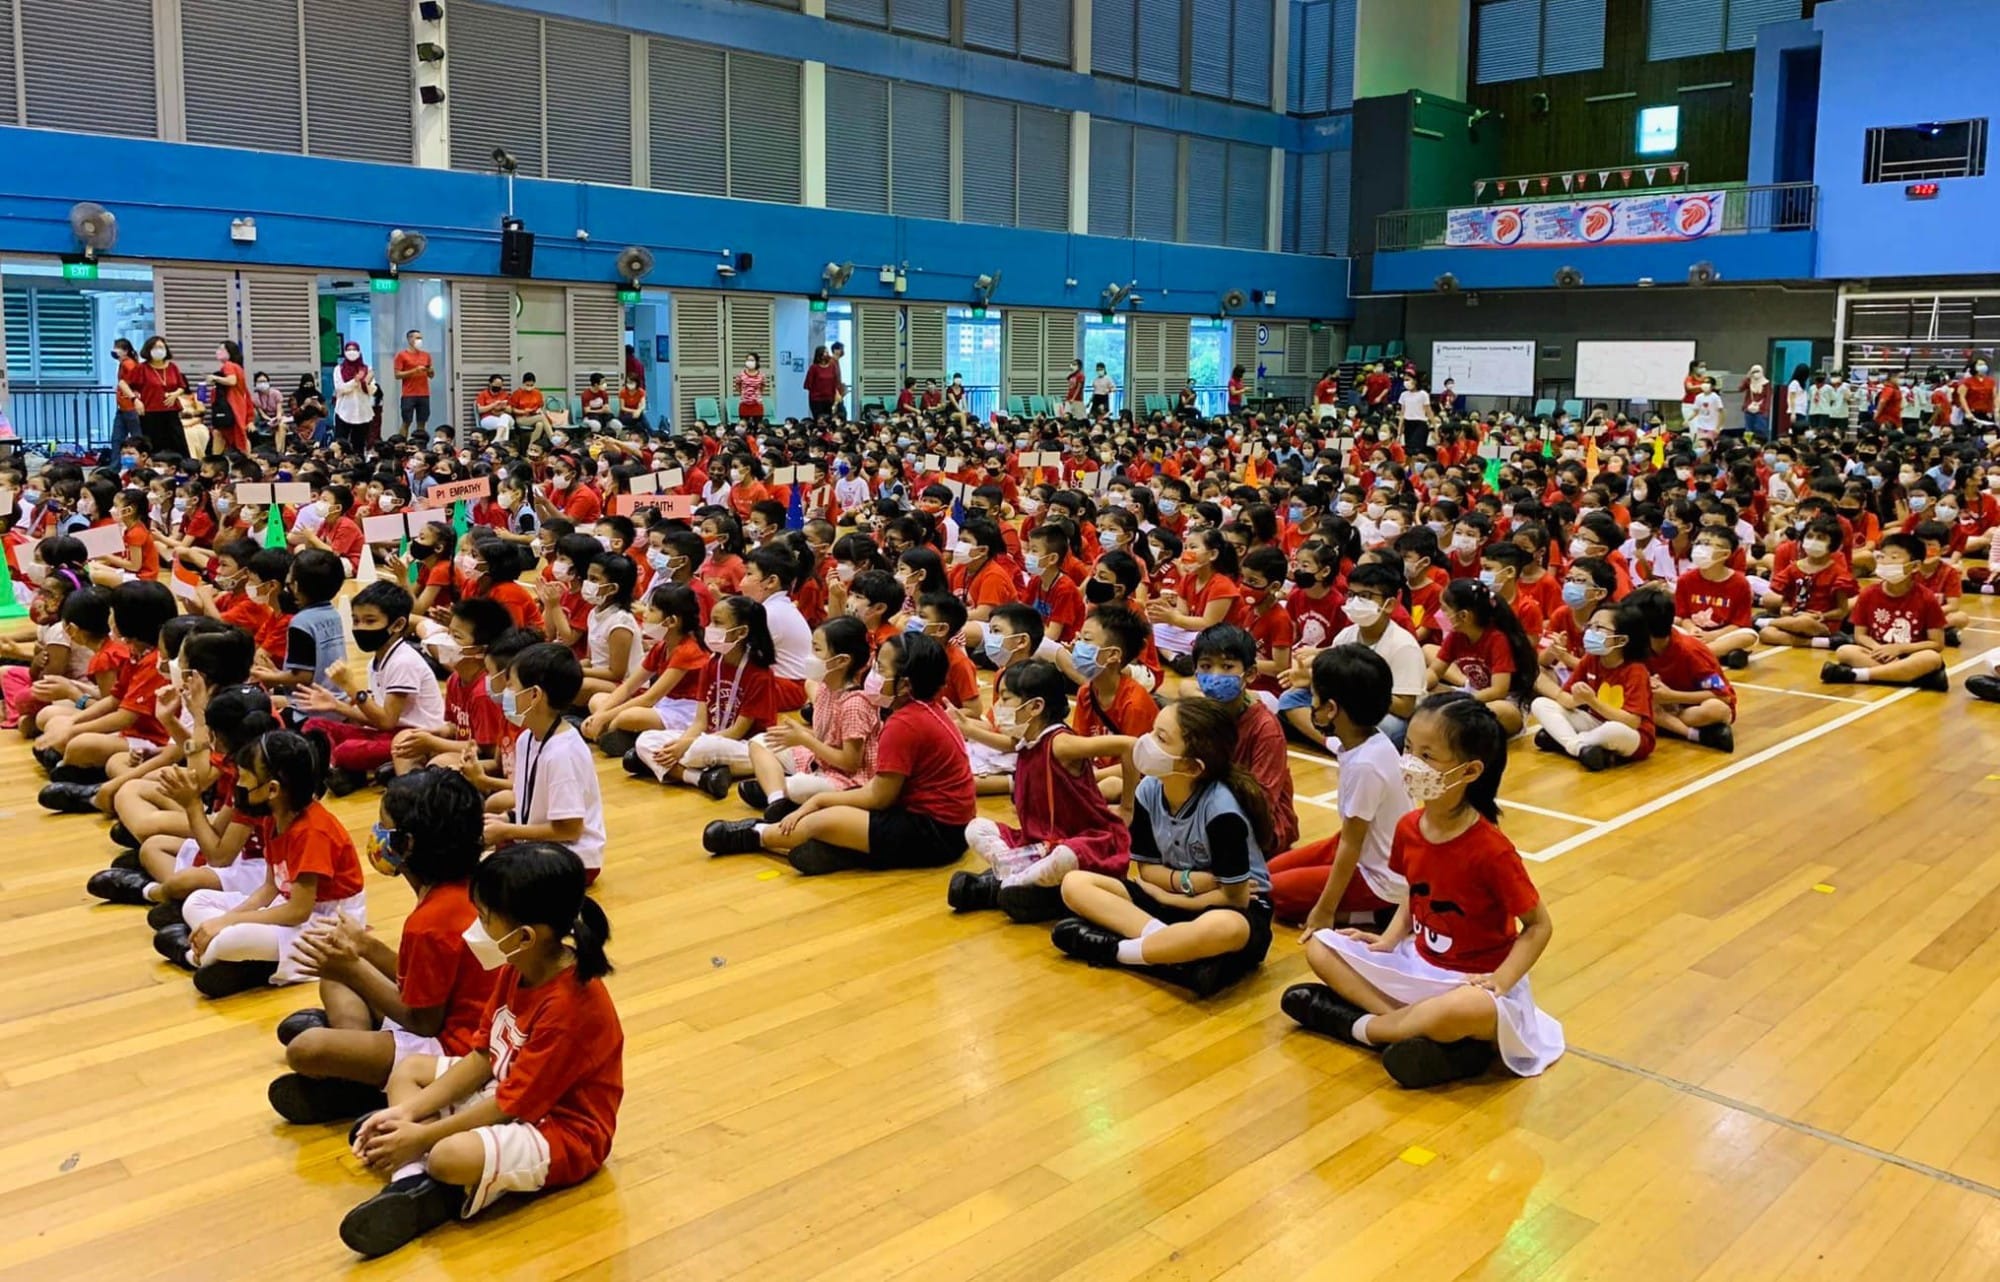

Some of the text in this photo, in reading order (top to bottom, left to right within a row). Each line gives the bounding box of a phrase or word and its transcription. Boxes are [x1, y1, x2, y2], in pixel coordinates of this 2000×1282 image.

[71, 267, 89, 277] EXIT
[375, 280, 391, 290] EXIT
[436, 483, 482, 499] P1 EMPATHY
[650, 501, 674, 512] FAITH
